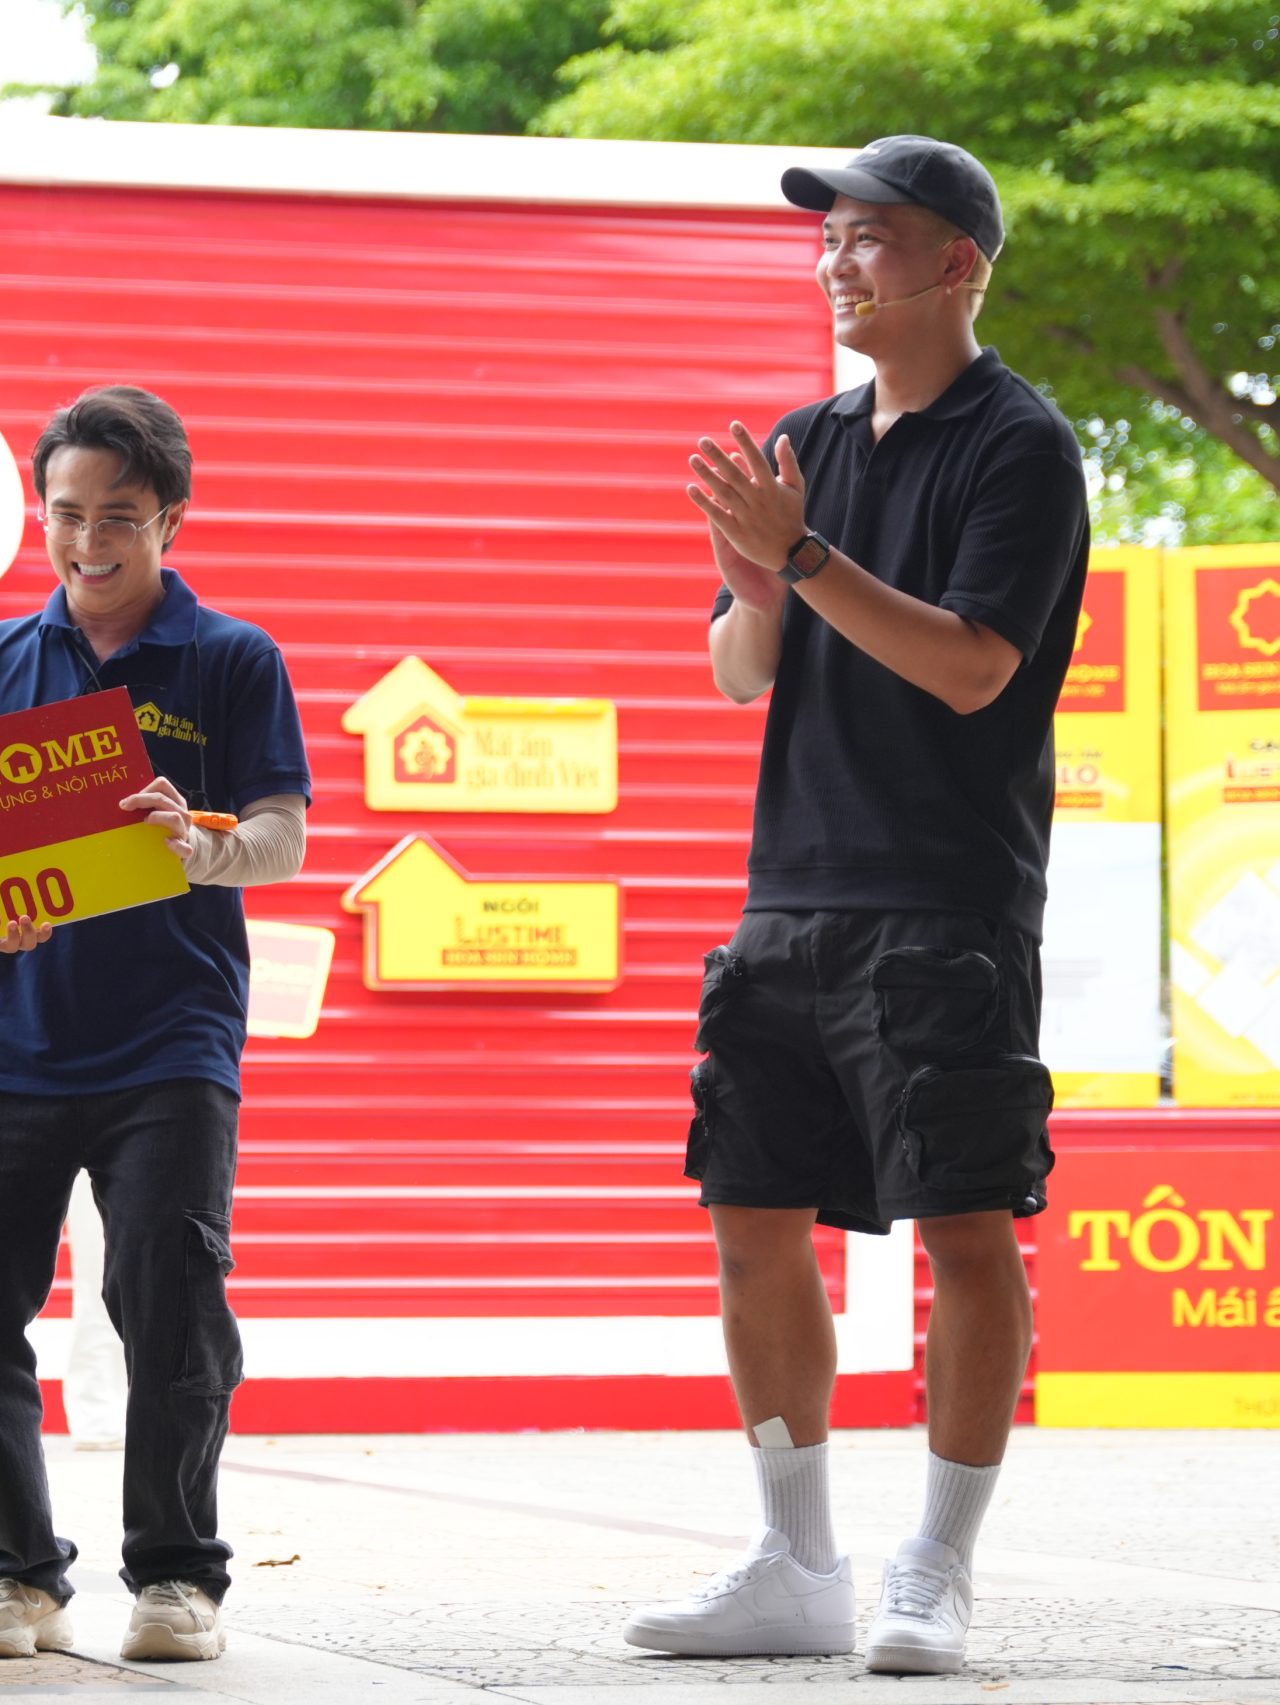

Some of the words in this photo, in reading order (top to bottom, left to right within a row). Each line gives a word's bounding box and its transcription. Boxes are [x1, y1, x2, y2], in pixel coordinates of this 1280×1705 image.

[41, 786, 54, 800] &
[56, 775, 88, 796] NỘI
[90, 764, 128, 787] THẤT
[1069, 1184, 1274, 1272] TÔN
[1172, 1286, 1257, 1328] Mái
